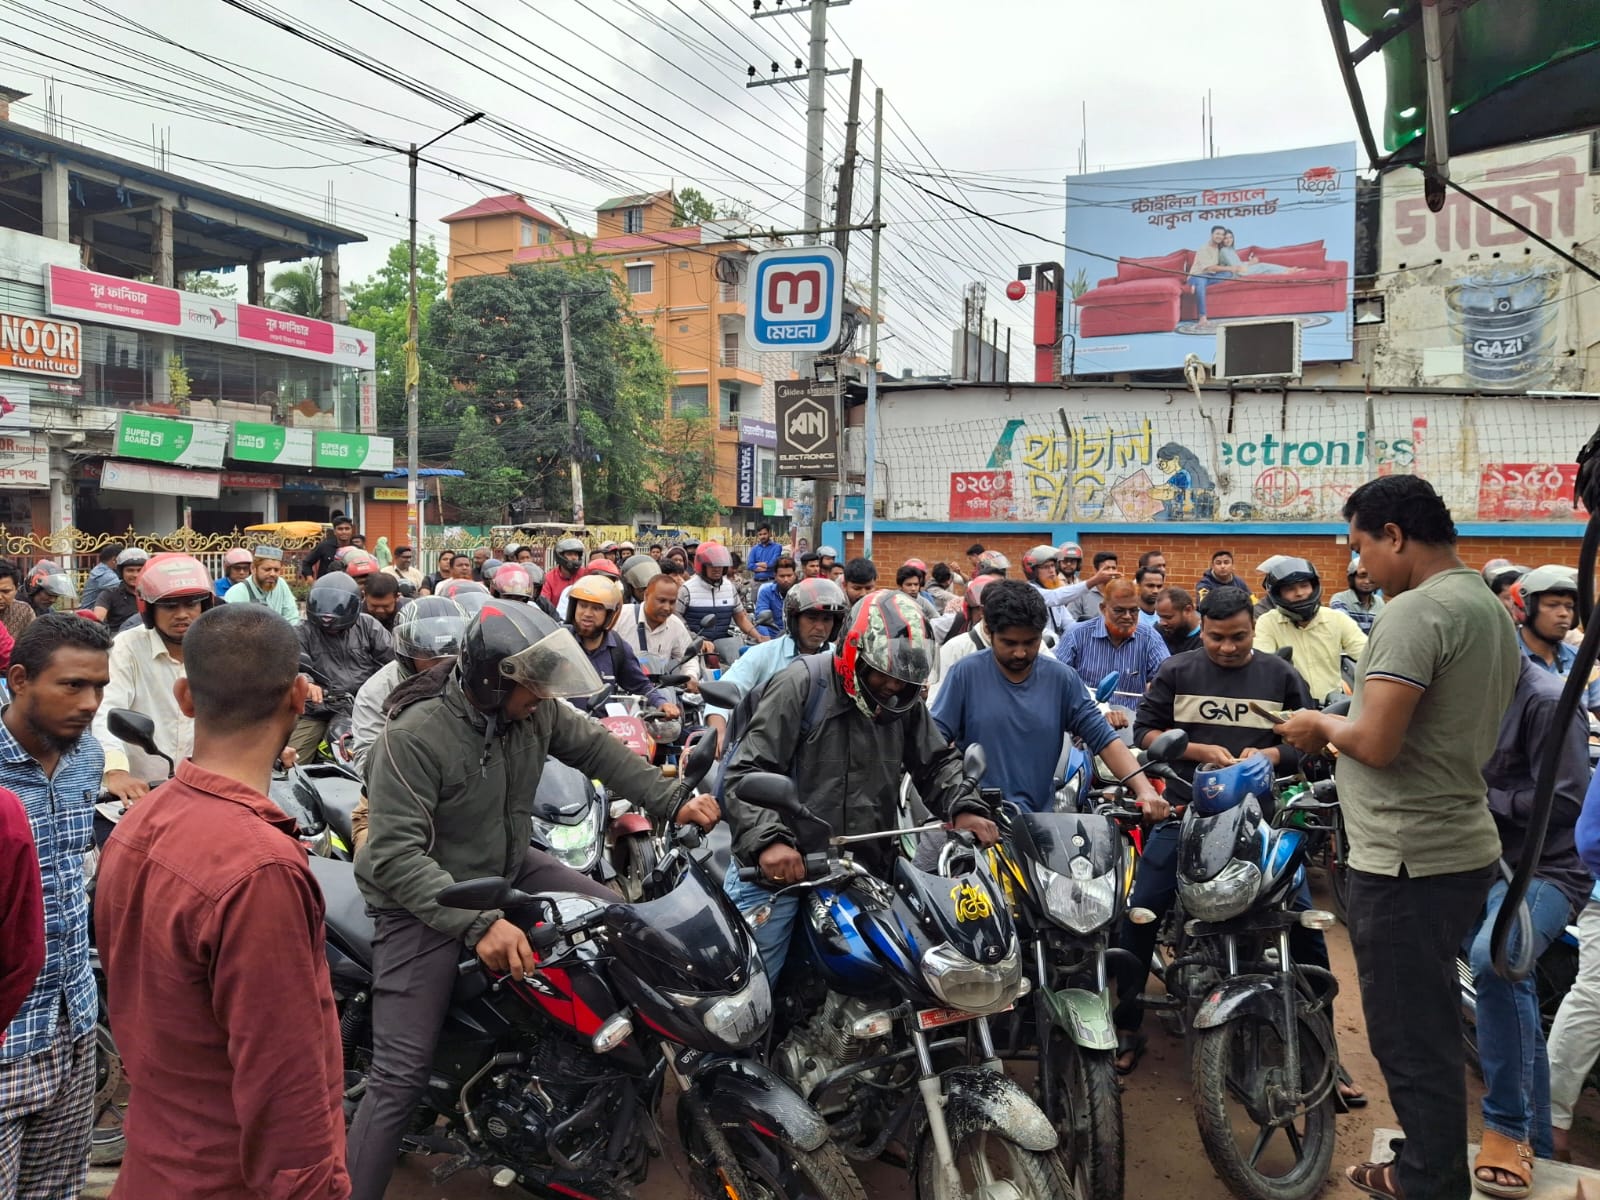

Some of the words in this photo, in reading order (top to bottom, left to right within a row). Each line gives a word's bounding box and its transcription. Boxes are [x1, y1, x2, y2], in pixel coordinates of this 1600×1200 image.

[1297, 173, 1341, 196] Regal
[1148, 210, 1192, 230] থাকুন
[1199, 198, 1279, 221] কমফোর্টে
[89, 282, 104, 298] নূর
[107, 286, 148, 304] ফার্নিচার
[1, 314, 75, 359] NOOR
[766, 324, 817, 340] মেঘনা
[1474, 338, 1522, 354] GAZI
[12, 354, 77, 374] furniture
[125, 435, 149, 444] BOARD
[126, 427, 150, 438] SUPER
[779, 453, 835, 461] ELECTRONICS
[741, 447, 750, 503] WALTON
[1199, 700, 1249, 722] GAP
